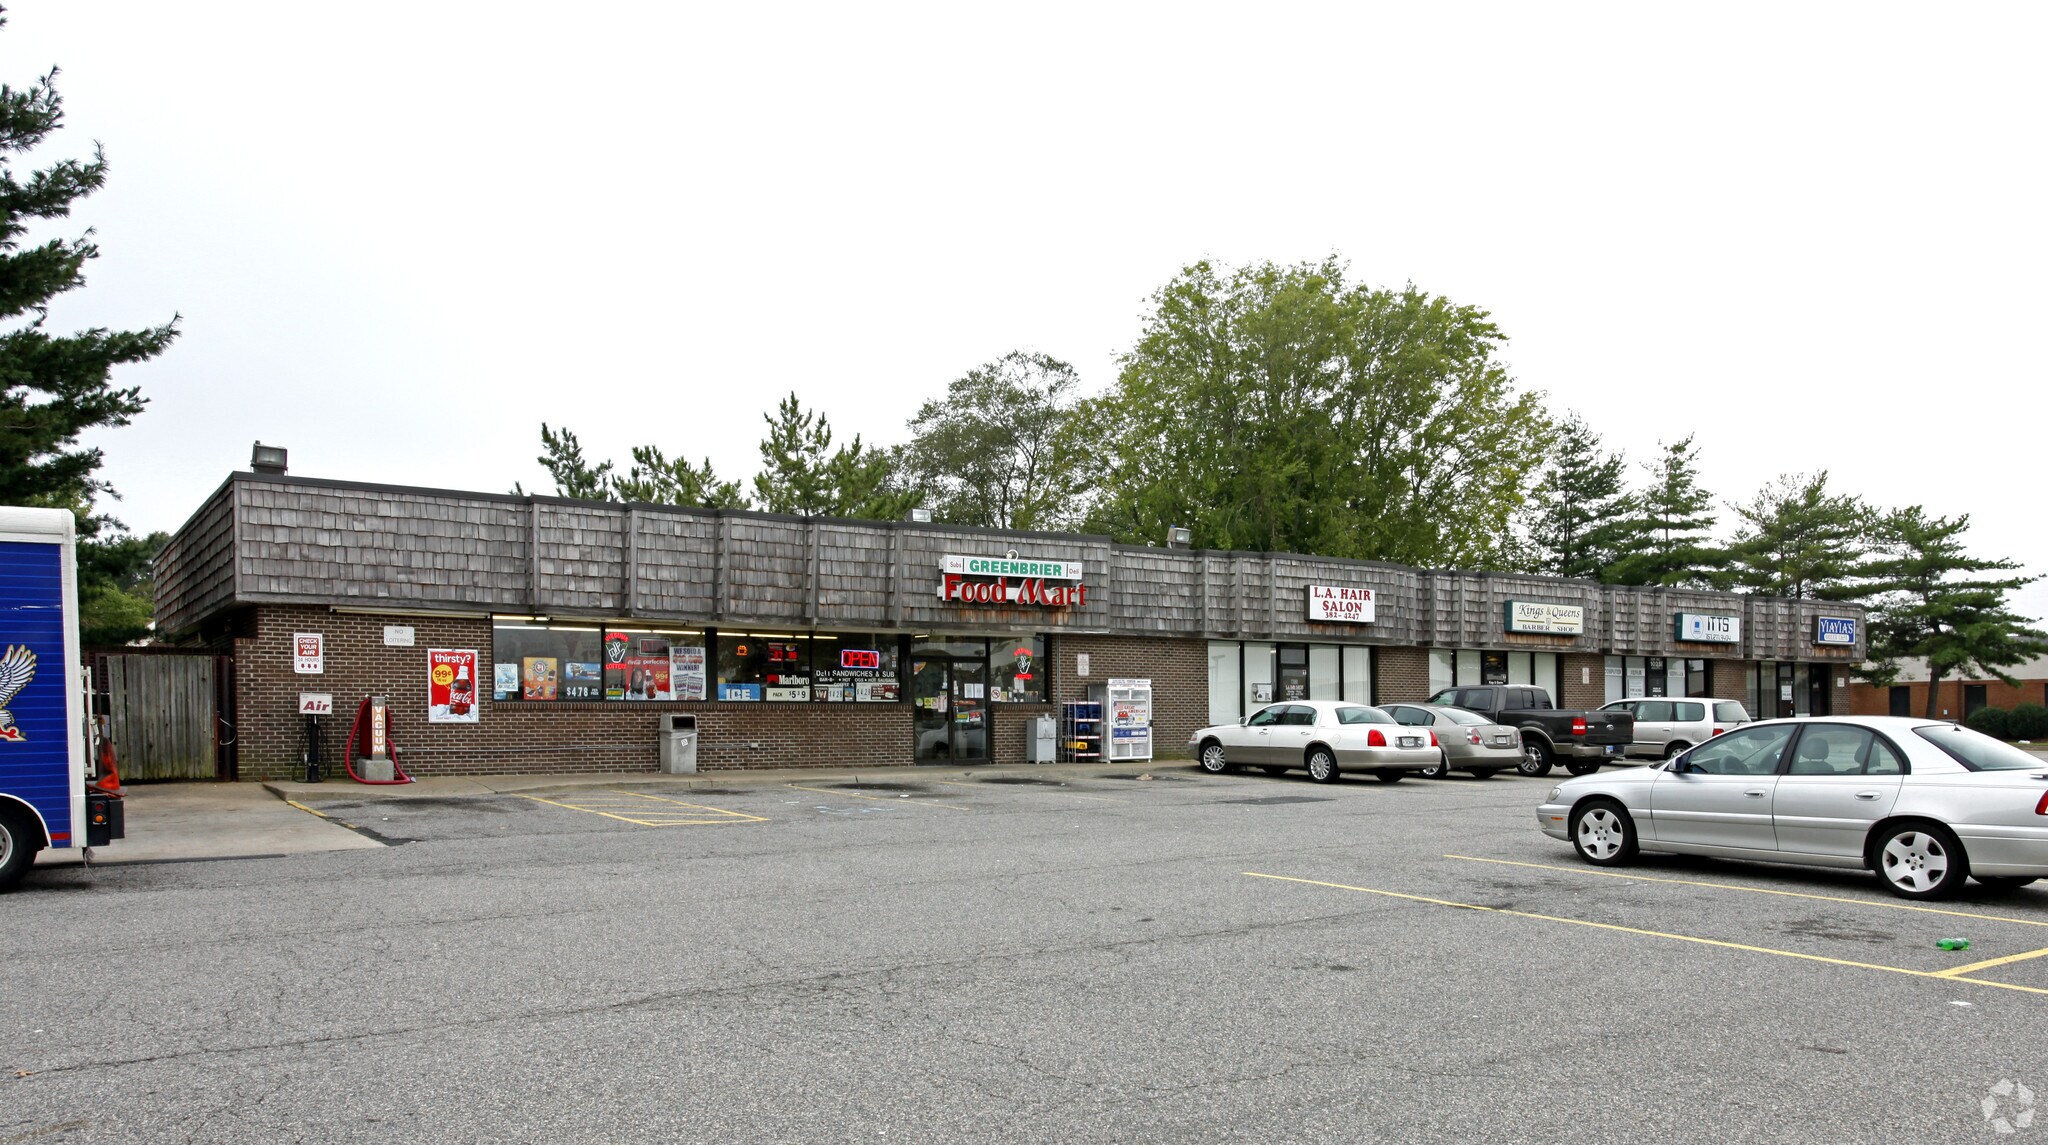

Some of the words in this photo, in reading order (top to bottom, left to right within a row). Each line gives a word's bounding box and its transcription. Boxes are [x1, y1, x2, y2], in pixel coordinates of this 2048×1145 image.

[950, 560, 962, 569] Subs
[969, 559, 1062, 576] GREENBRIER
[944, 573, 1008, 602] Food
[1016, 577, 1088, 607] Mart
[1314, 587, 1337, 599] L.A.
[1341, 589, 1371, 601] HAIR
[1322, 600, 1362, 612] SALON
[1519, 604, 1544, 619] Kings
[1546, 606, 1551, 616] &
[1552, 607, 1580, 619] Queens
[1708, 616, 1730, 632] ITTS
[1820, 620, 1853, 634] YIAYIA'S
[434, 654, 471, 664] thirsty?
[843, 651, 877, 667] OPEN
[434, 670, 452, 678] 99¢
[779, 675, 809, 685] Marlboro
[726, 689, 750, 700] ICE
[303, 701, 330, 711] Air
[374, 706, 384, 752] VACUUM
